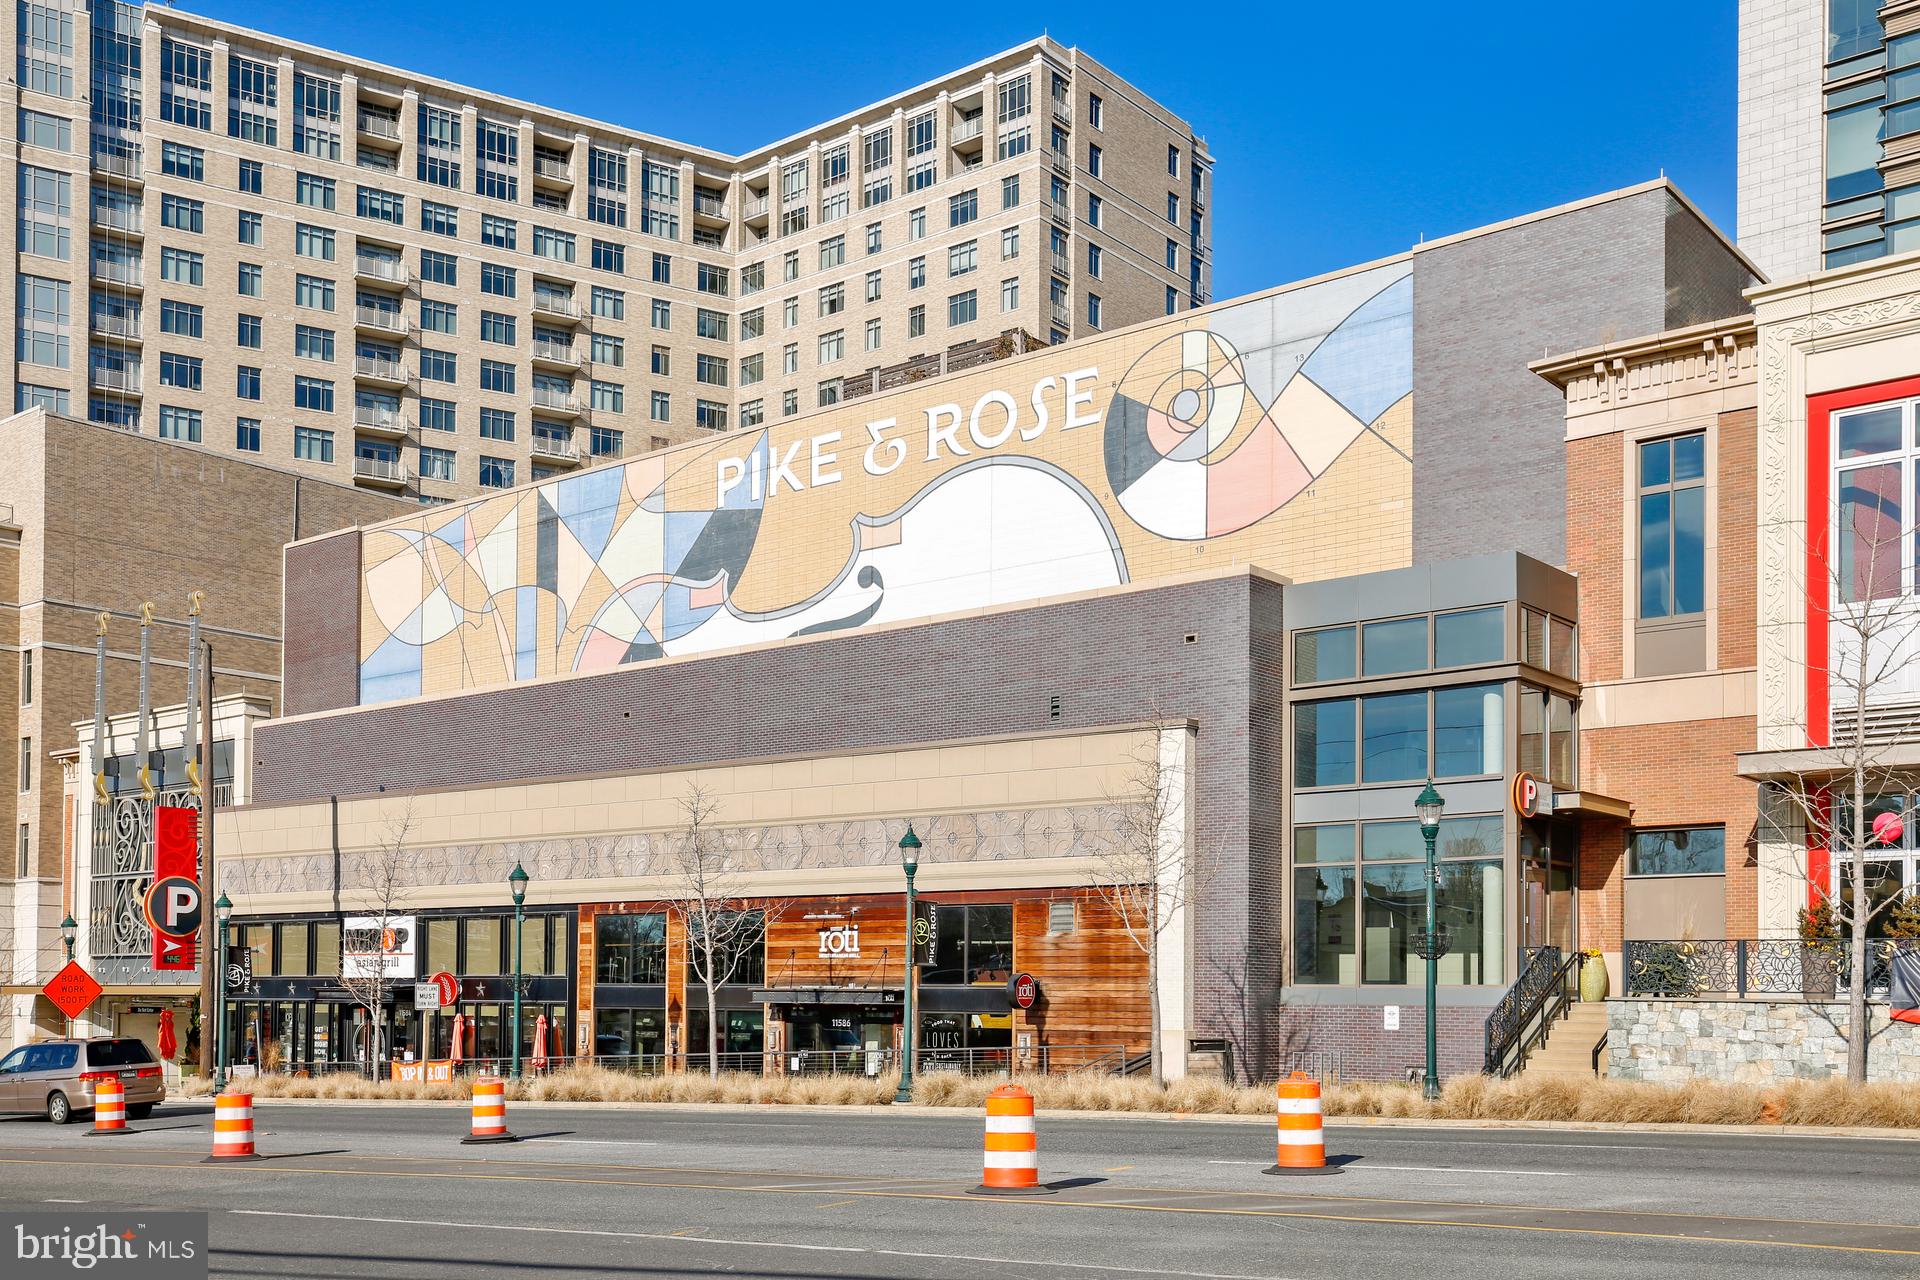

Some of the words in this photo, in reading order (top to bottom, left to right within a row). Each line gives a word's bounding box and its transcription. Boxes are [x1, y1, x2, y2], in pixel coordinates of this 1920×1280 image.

[1375, 421, 1386, 430] 12
[716, 431, 842, 508] PIKE
[862, 416, 907, 476] &
[922, 366, 1104, 463] ROSE
[1306, 489, 1316, 497] 11
[1195, 546, 1204, 554] 10
[1523, 779, 1537, 809] P
[166, 886, 199, 927] P
[930, 931, 937, 940] &
[928, 941, 936, 964] PIKE
[62, 975, 85, 983] ROAD
[58, 996, 76, 1004] 1500
[79, 996, 88, 1004] FT
[832, 1019, 851, 1027] 11586
[926, 1031, 959, 1048] LOVES
[435, 1065, 449, 1080] OUT
